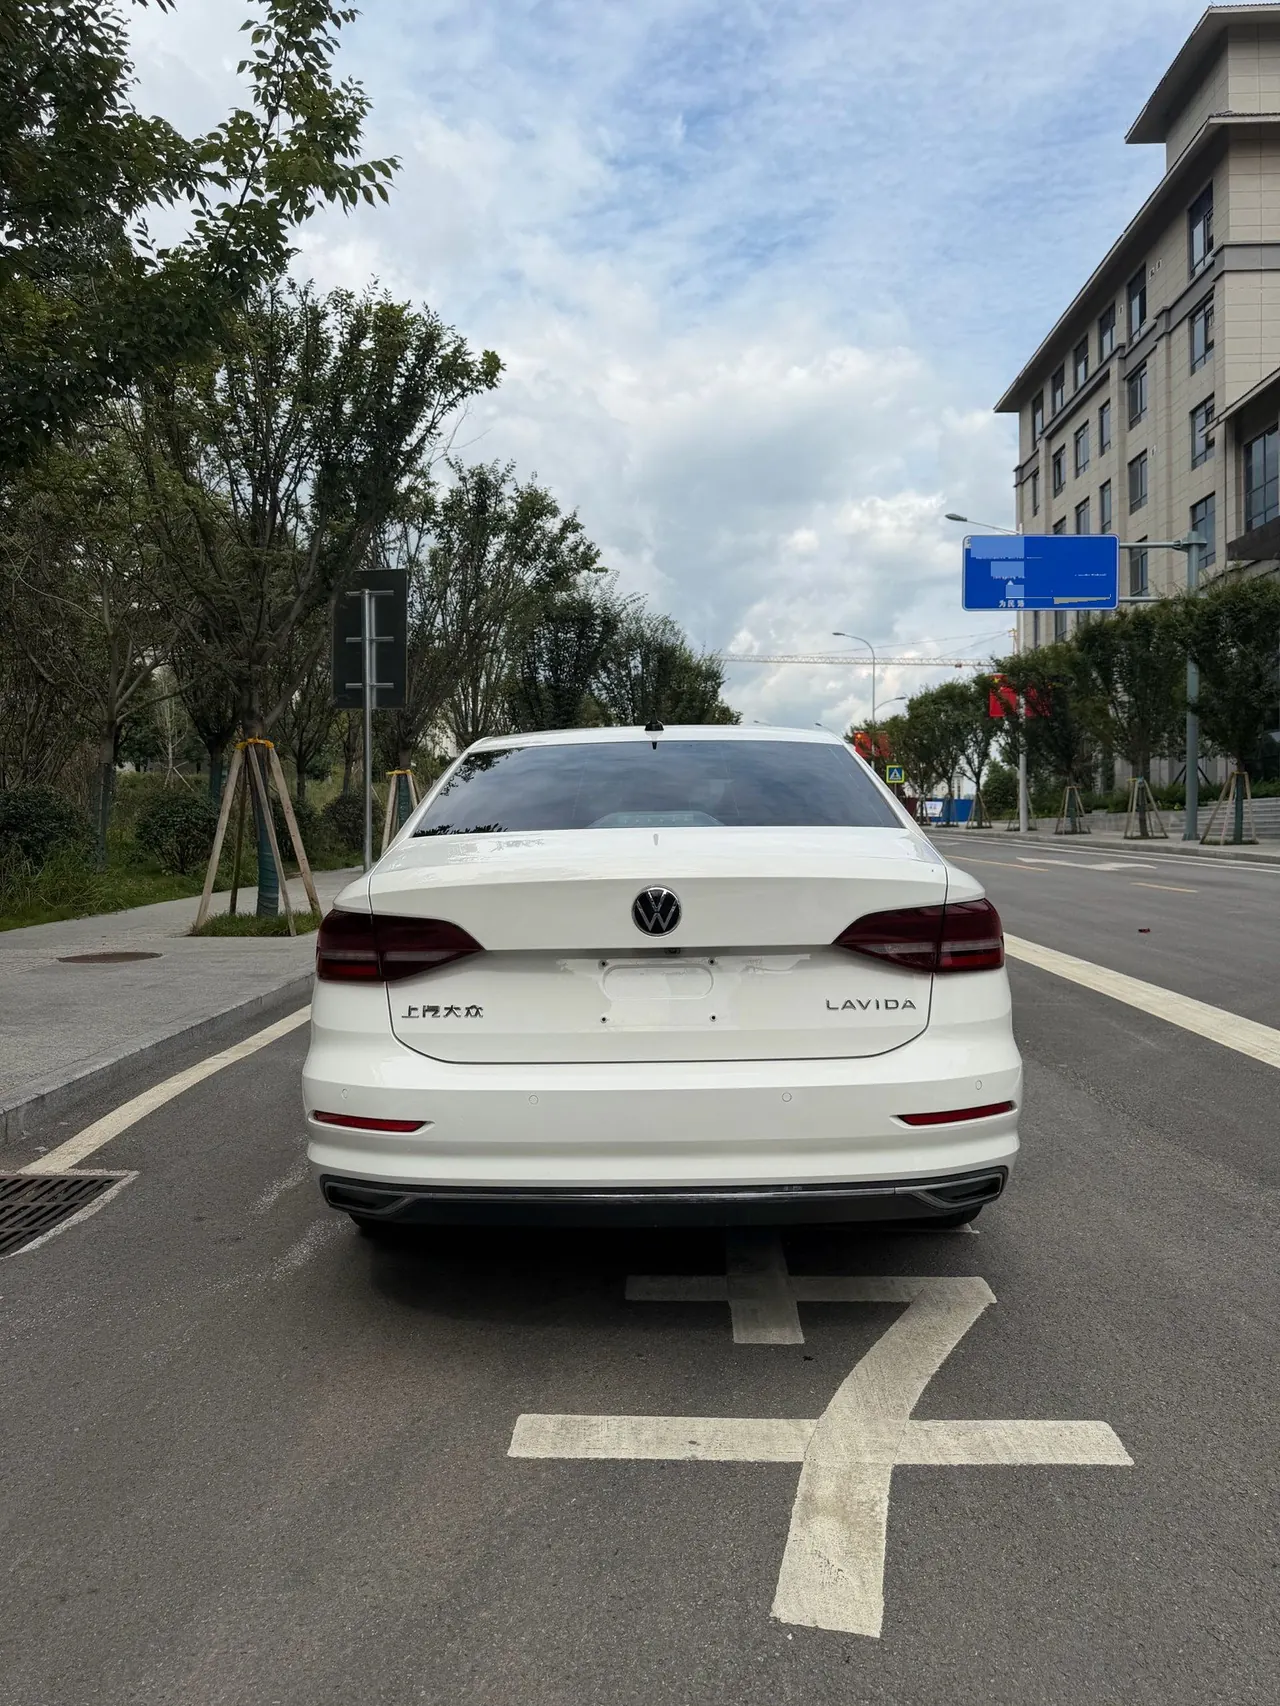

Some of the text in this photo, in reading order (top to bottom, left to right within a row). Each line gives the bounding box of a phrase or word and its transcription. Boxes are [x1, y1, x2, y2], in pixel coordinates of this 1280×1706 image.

[401, 1004, 484, 1019] 上汽大众
[825, 998, 917, 1011] LAVIDA
